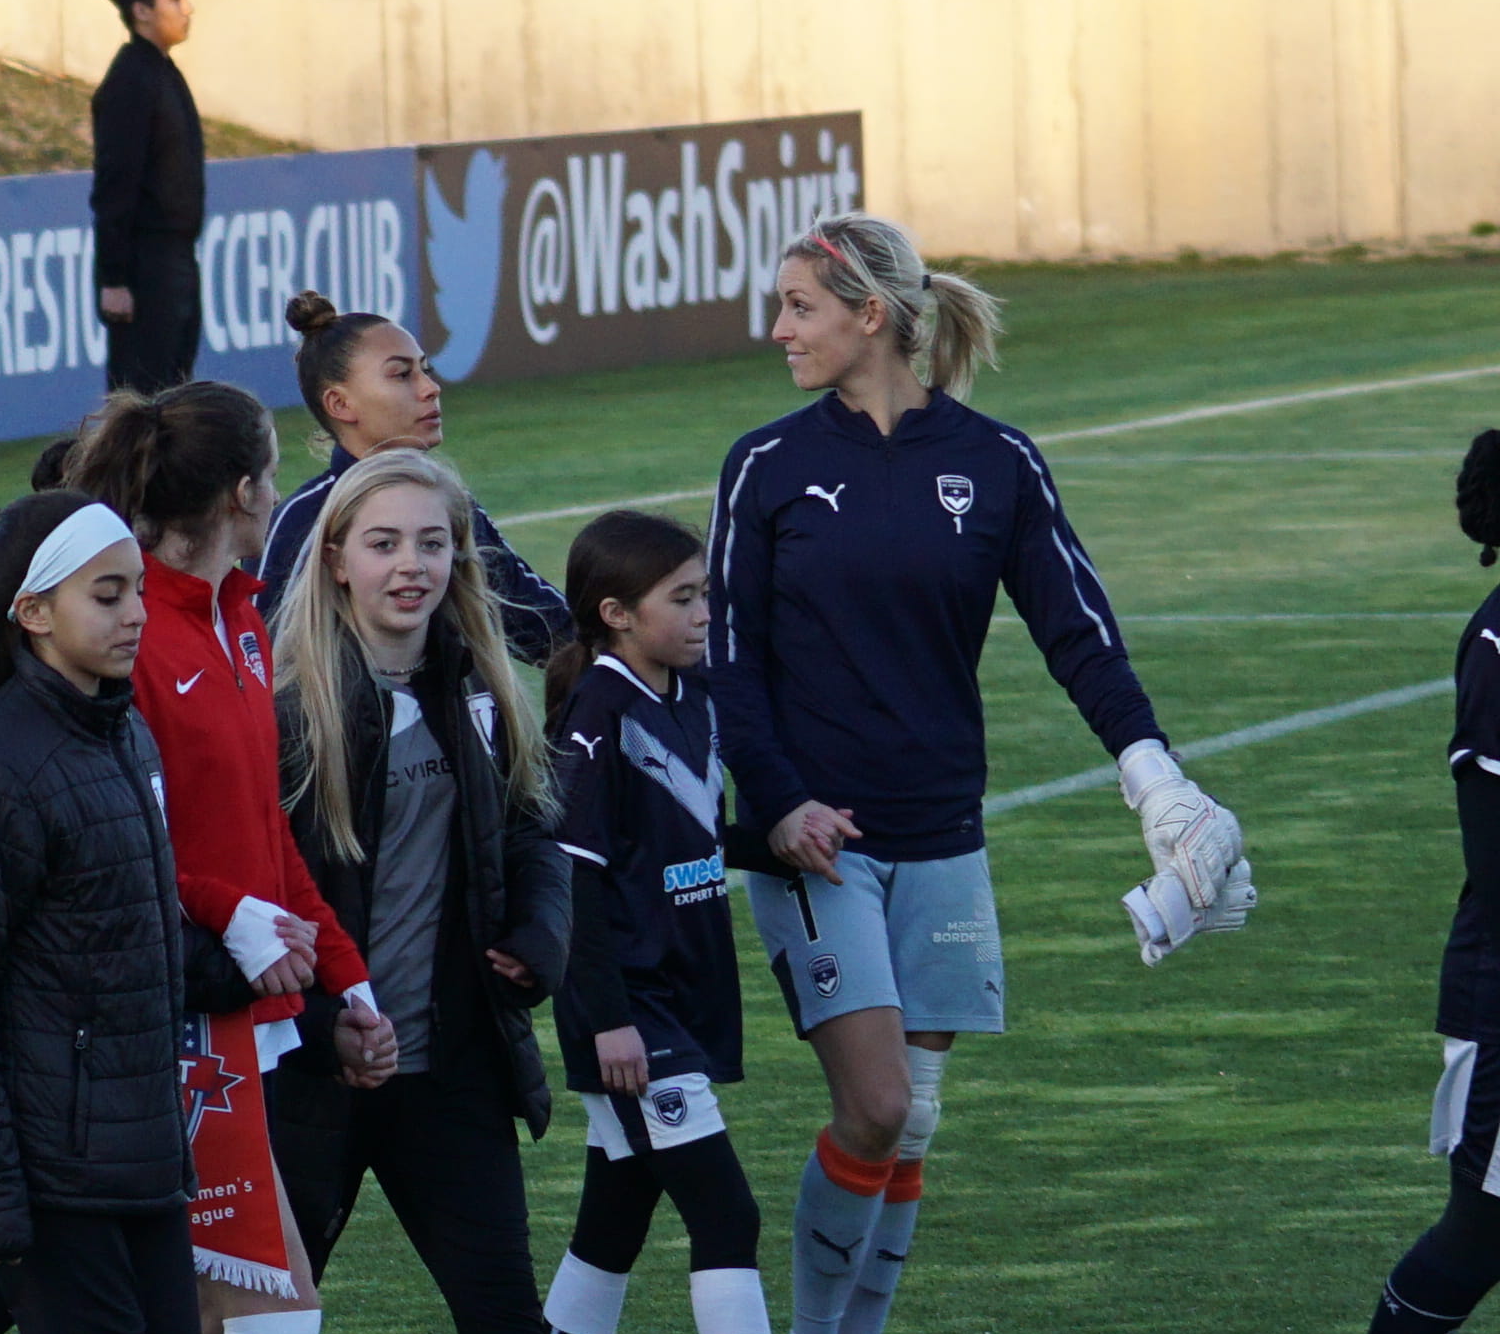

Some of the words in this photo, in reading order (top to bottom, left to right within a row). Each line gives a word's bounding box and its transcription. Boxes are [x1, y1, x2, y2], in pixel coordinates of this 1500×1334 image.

[194, 210, 299, 352] CCER
[304, 200, 404, 325] CLUB
[953, 516, 962, 534] 1
[674, 888, 713, 906] EXPERT
[785, 873, 822, 945] 1
[192, 1176, 253, 1202] men's
[190, 1205, 235, 1227] ague
